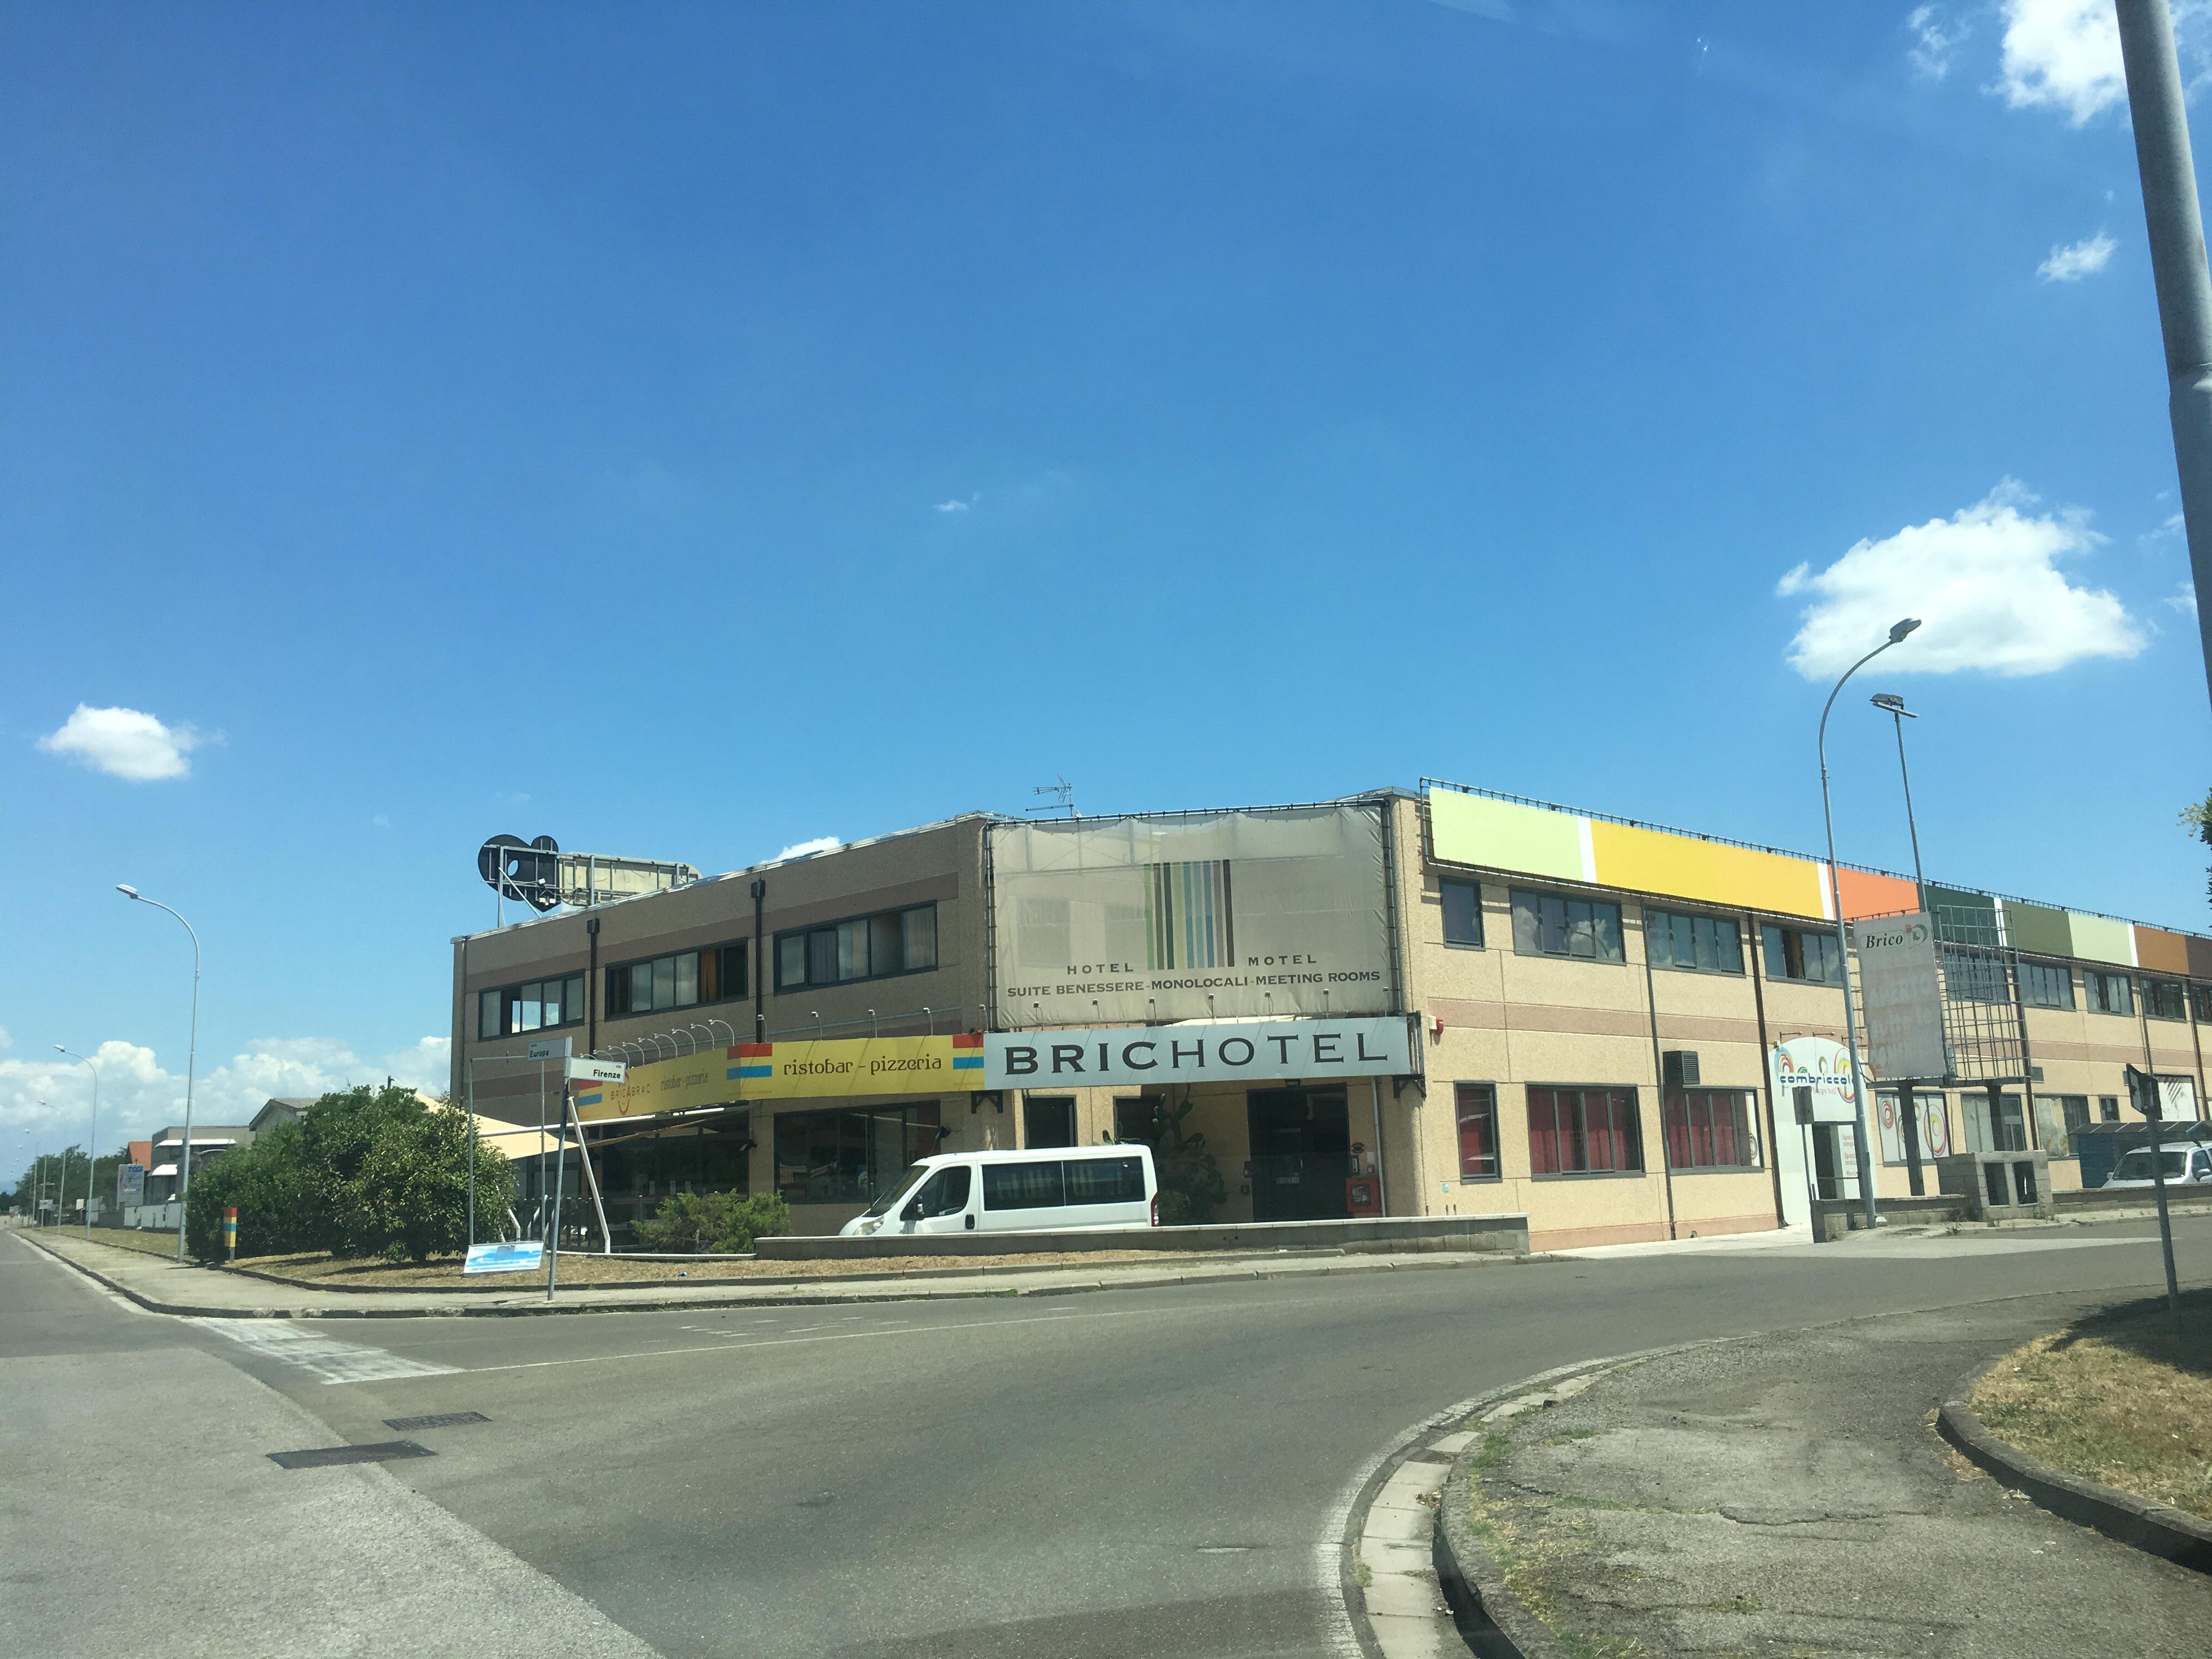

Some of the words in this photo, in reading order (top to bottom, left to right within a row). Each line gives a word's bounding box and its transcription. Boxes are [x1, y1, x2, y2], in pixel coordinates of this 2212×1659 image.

[1865, 933, 1903, 949] Brico
[1248, 955, 1317, 966] MOTEL
[1066, 962, 1133, 975] HOTEL
[1007, 986, 1051, 997] SUITE
[1328, 970, 1380, 983] ROOMS
[529, 1049, 549, 1058] Europa
[1005, 1032, 1388, 1075] BRICHOTEL
[783, 1059, 853, 1075] ristobar
[871, 1053, 942, 1075] pizzeria
[593, 1069, 621, 1079] Firenze
[1780, 1073, 1854, 1085] combriccol
